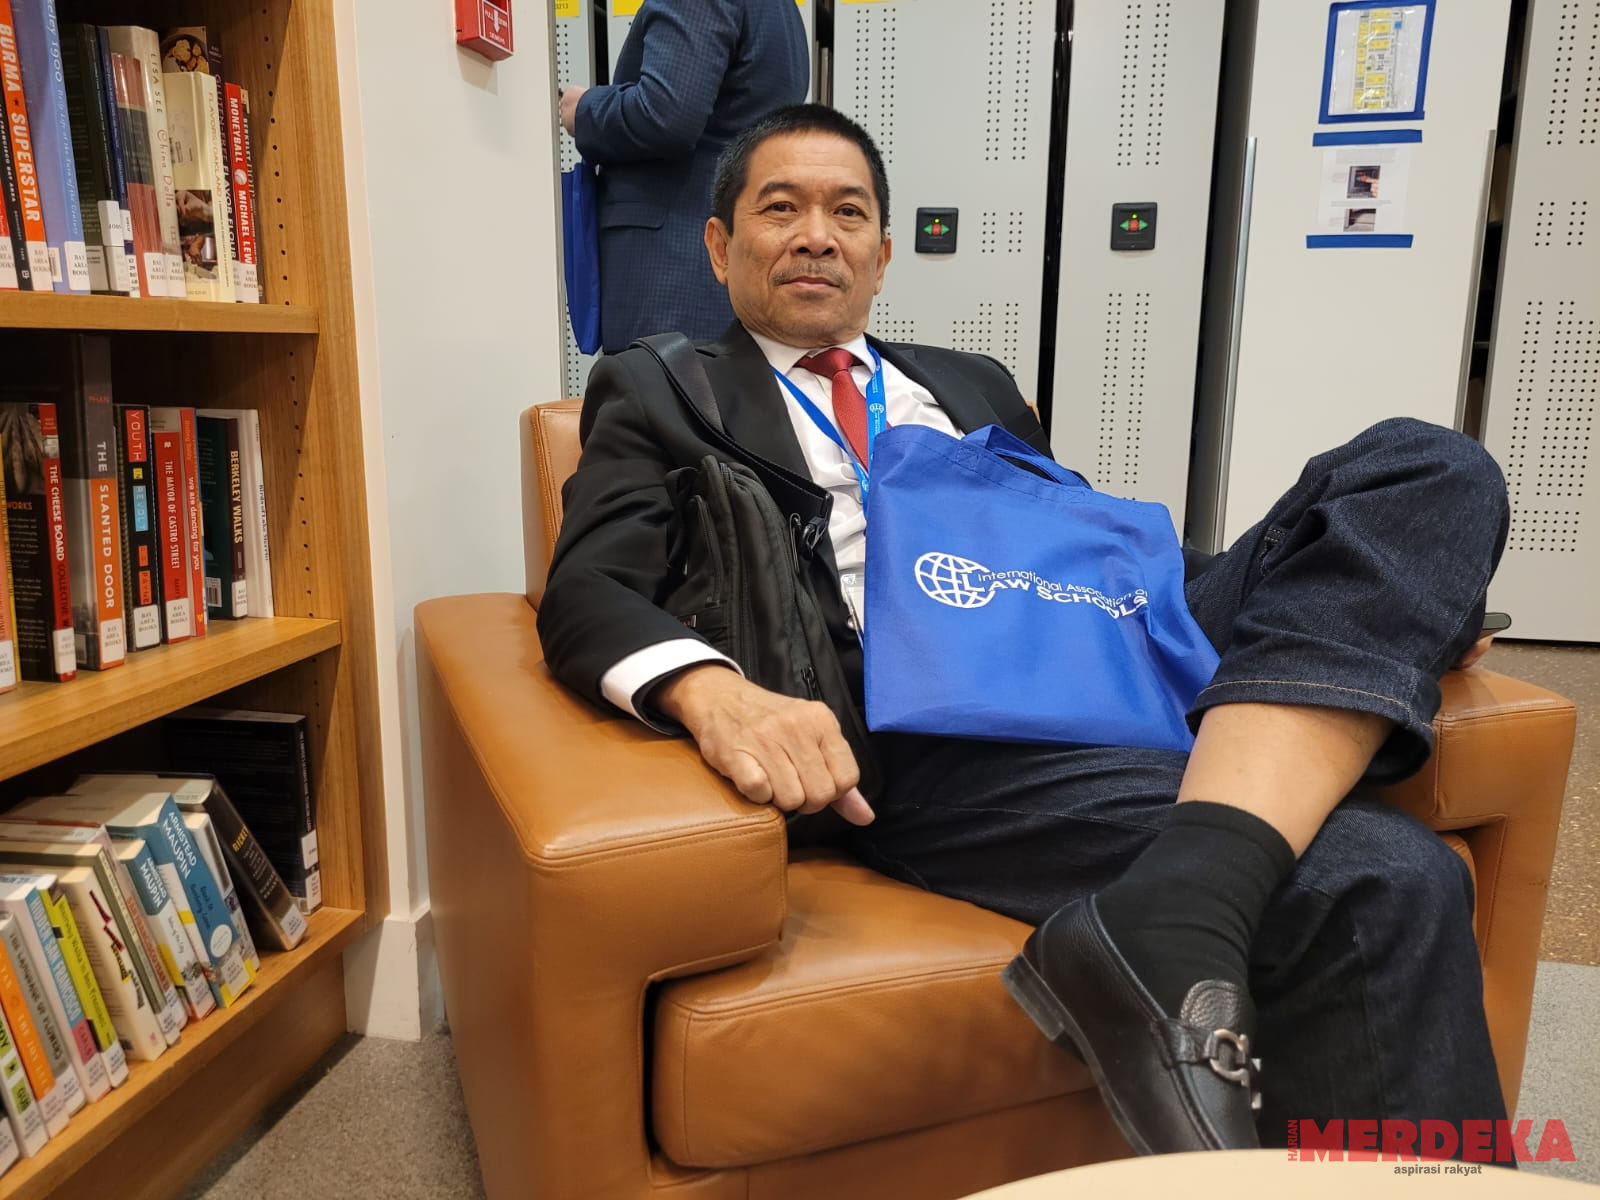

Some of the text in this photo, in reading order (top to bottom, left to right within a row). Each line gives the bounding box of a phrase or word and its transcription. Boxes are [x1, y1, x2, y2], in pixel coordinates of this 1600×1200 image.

[50, 42, 63, 82] 1900
[0, 24, 40, 221] BURMA SUPERSTAR
[155, 91, 163, 113] SEE
[157, 129, 174, 208] China Dolls
[223, 165, 232, 216] FLAVOR
[230, 97, 253, 264] MONEYBALL MICHAEL LEW
[227, 218, 237, 260] FLOUR
[130, 411, 142, 461] YOUTH
[49, 465, 59, 484] THE
[188, 476, 195, 489] we
[230, 450, 244, 544] BERKELEY WALKS
[51, 486, 62, 522] CHEESE
[97, 441, 115, 609] THE SLANTED DOOR
[164, 460, 180, 569] THE MAYOR OF CASTRO STREET
[190, 506, 199, 539] dancing
[54, 525, 66, 562] BOARD
[192, 554, 200, 570] you
[961, 573, 1149, 620] LAW SCHOOLS
[978, 569, 1063, 593] International
[1066, 583, 1132, 607] Association
[163, 819, 192, 880] MAUPIN
[168, 811, 198, 867] ARMISTEAD
[140, 862, 163, 908] MAUPIN
[146, 857, 168, 898] ARMISTEAD
[31, 896, 82, 1020] HIDDEN SAN FRANCISCO
